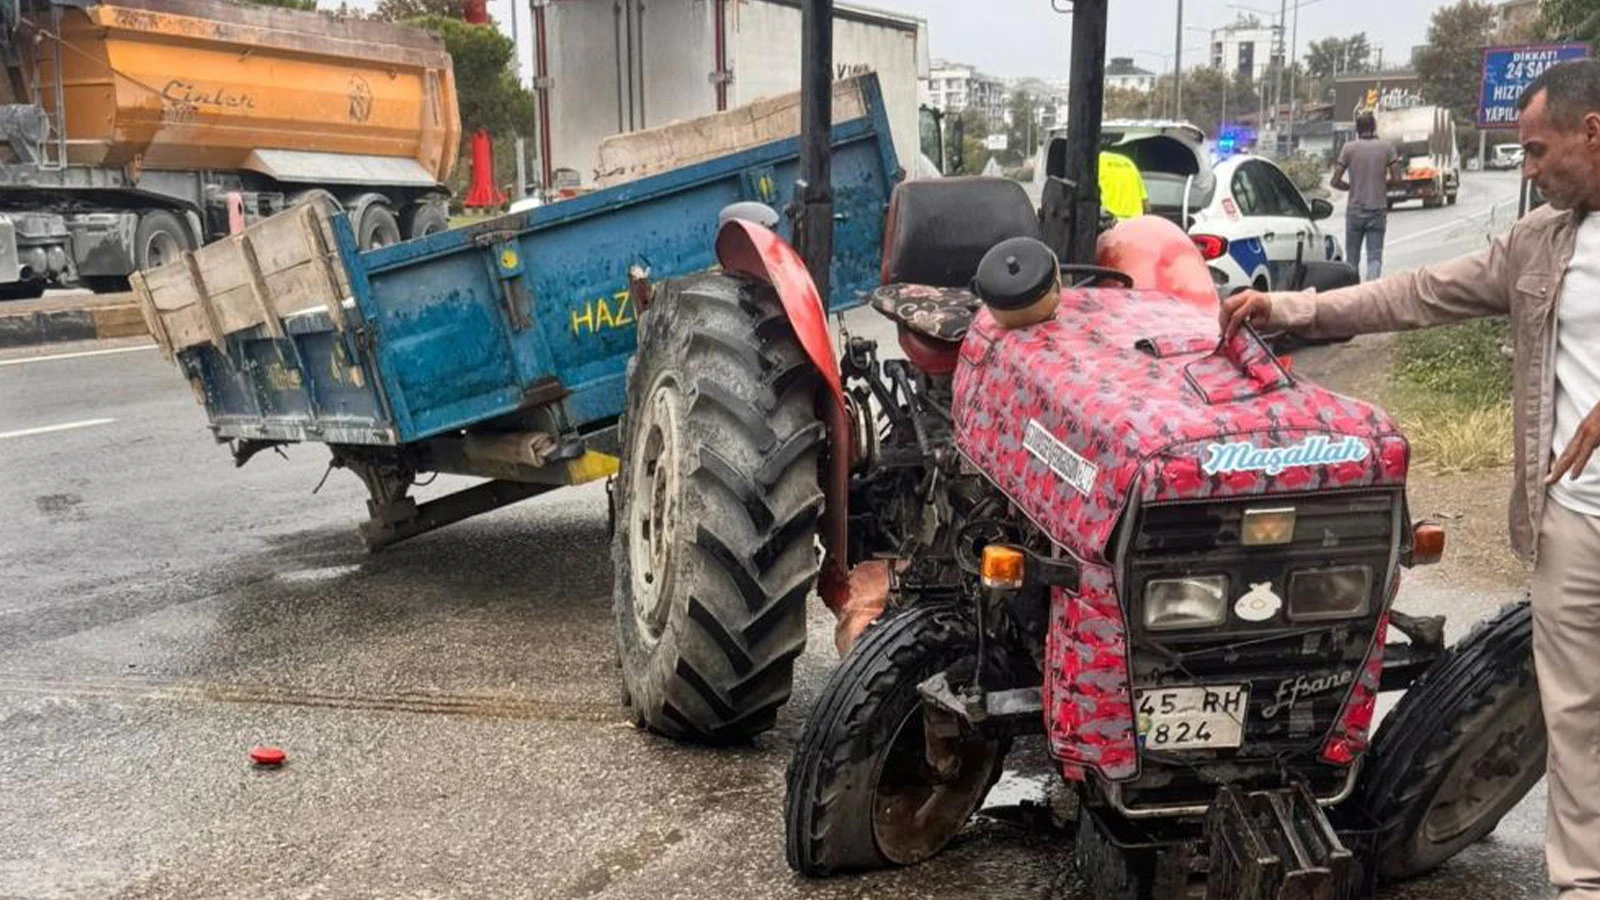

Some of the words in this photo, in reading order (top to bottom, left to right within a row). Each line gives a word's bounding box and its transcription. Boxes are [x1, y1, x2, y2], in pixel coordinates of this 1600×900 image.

[1505, 62, 1523, 79] 24
[1526, 61, 1559, 78] SAA
[571, 290, 638, 337] HAZ
[1205, 438, 1366, 474] Maşallah
[1139, 693, 1178, 716] 45
[1202, 691, 1242, 713] RH
[1262, 669, 1352, 719] Efsane
[1154, 721, 1212, 744] 824
